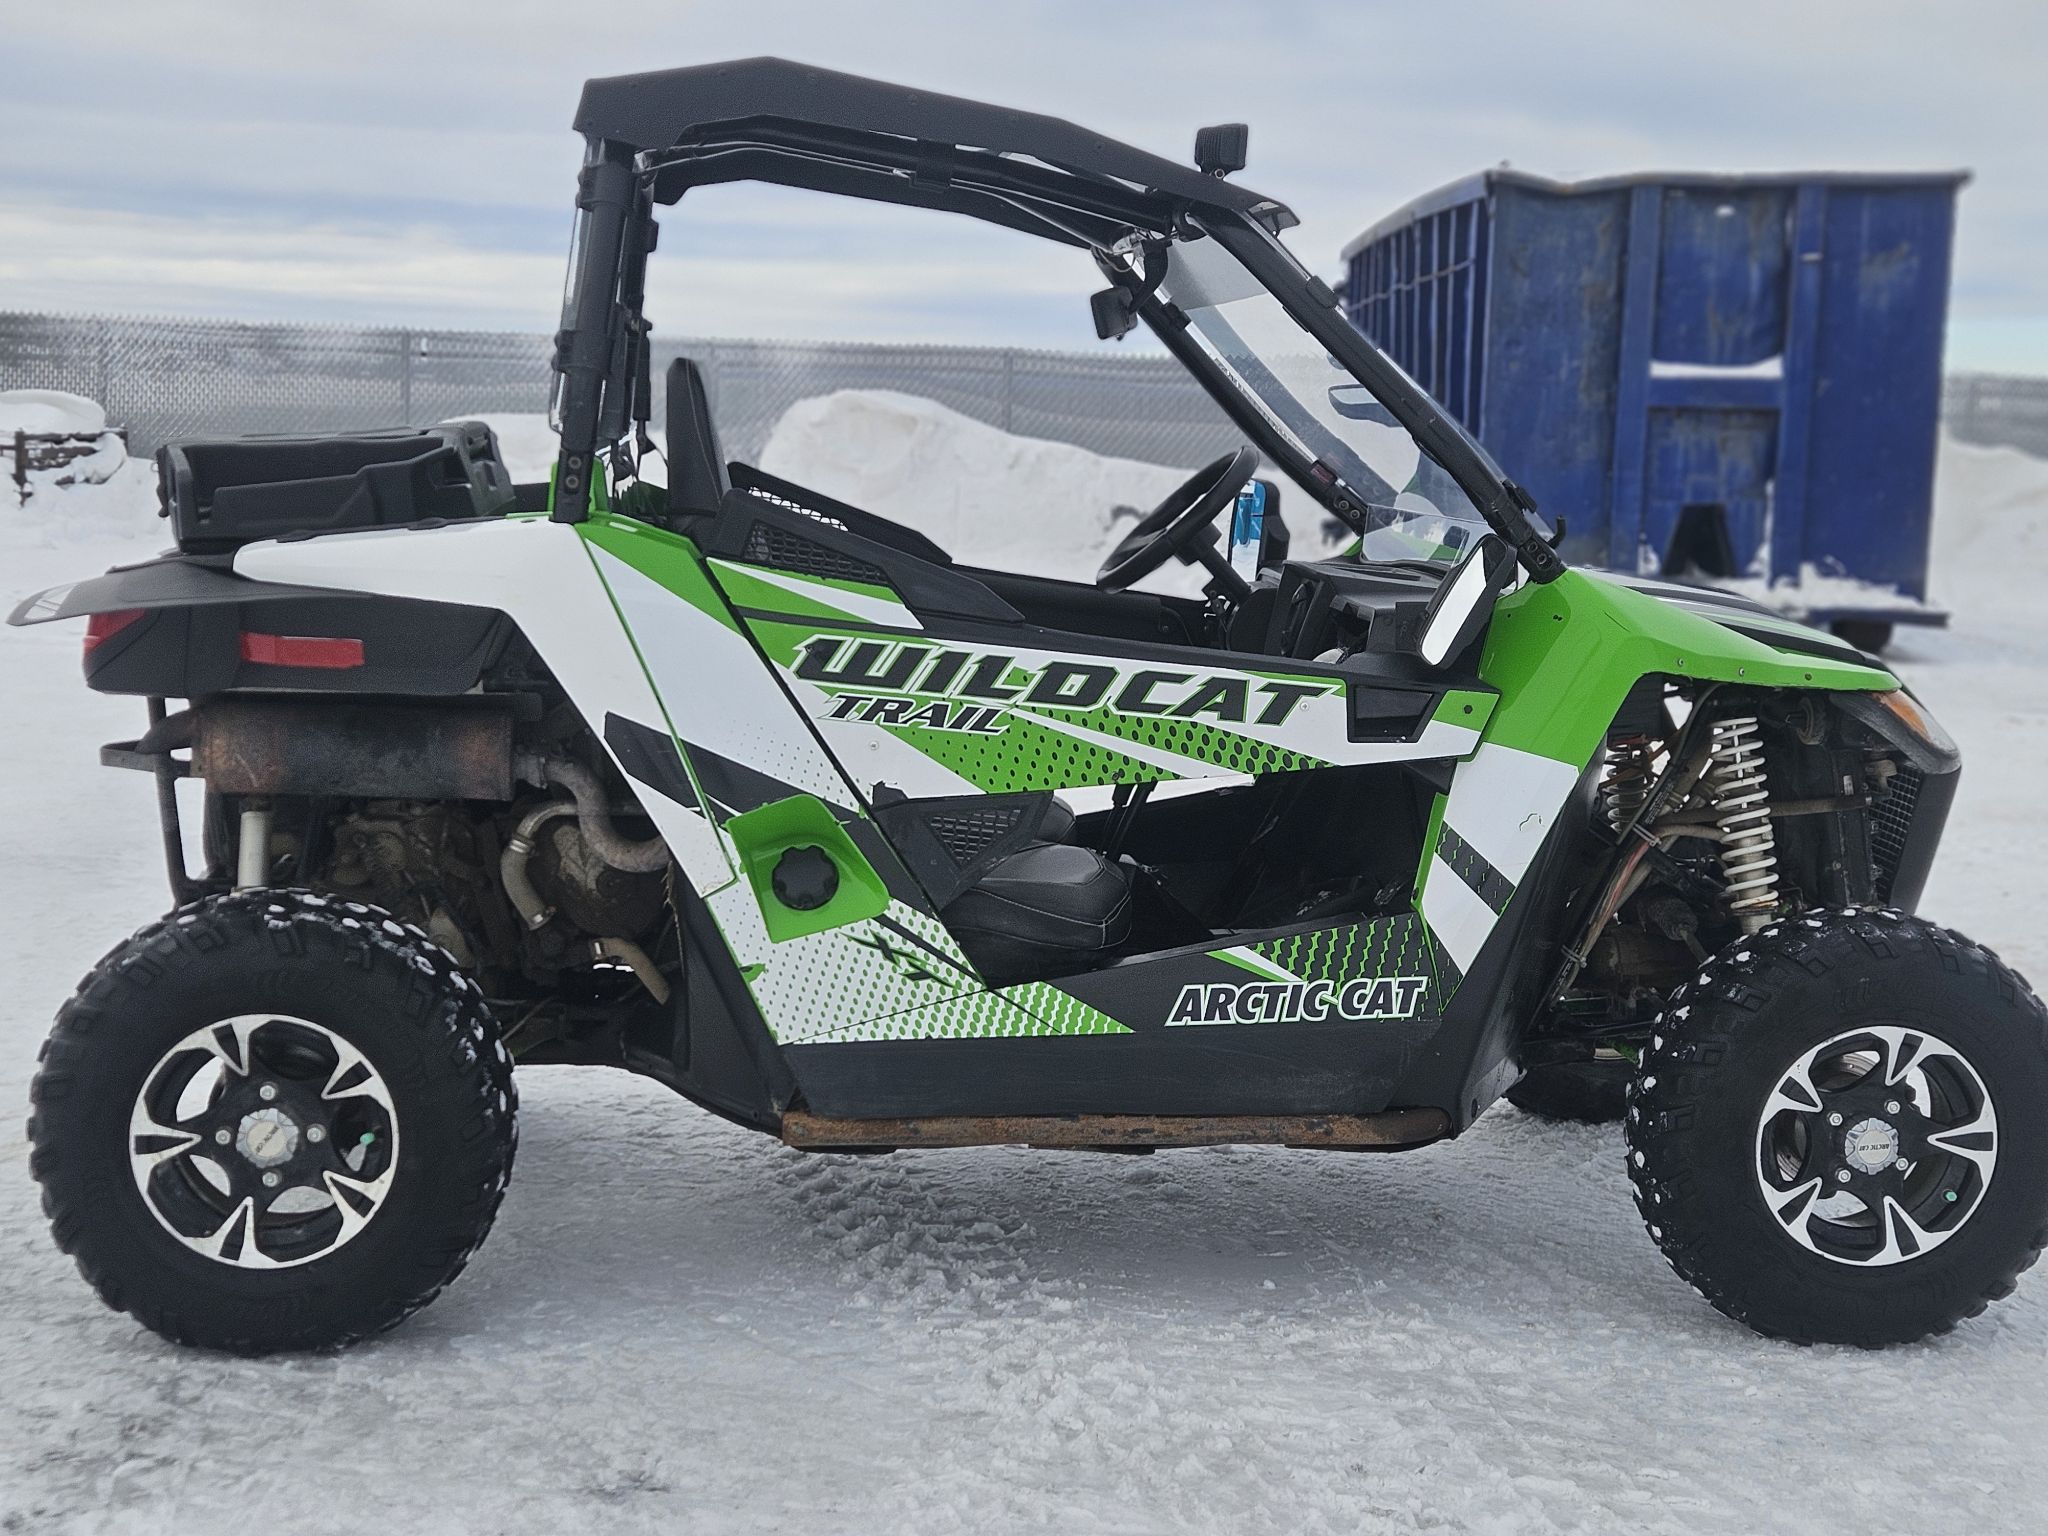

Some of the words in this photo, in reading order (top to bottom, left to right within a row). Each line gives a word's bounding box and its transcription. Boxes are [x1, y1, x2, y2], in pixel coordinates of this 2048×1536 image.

[792, 634, 1336, 727] WILDCAT
[819, 692, 1011, 736] TRAIL
[1165, 980, 1335, 1027] ARCTIC
[1337, 976, 1429, 1020] CAT
